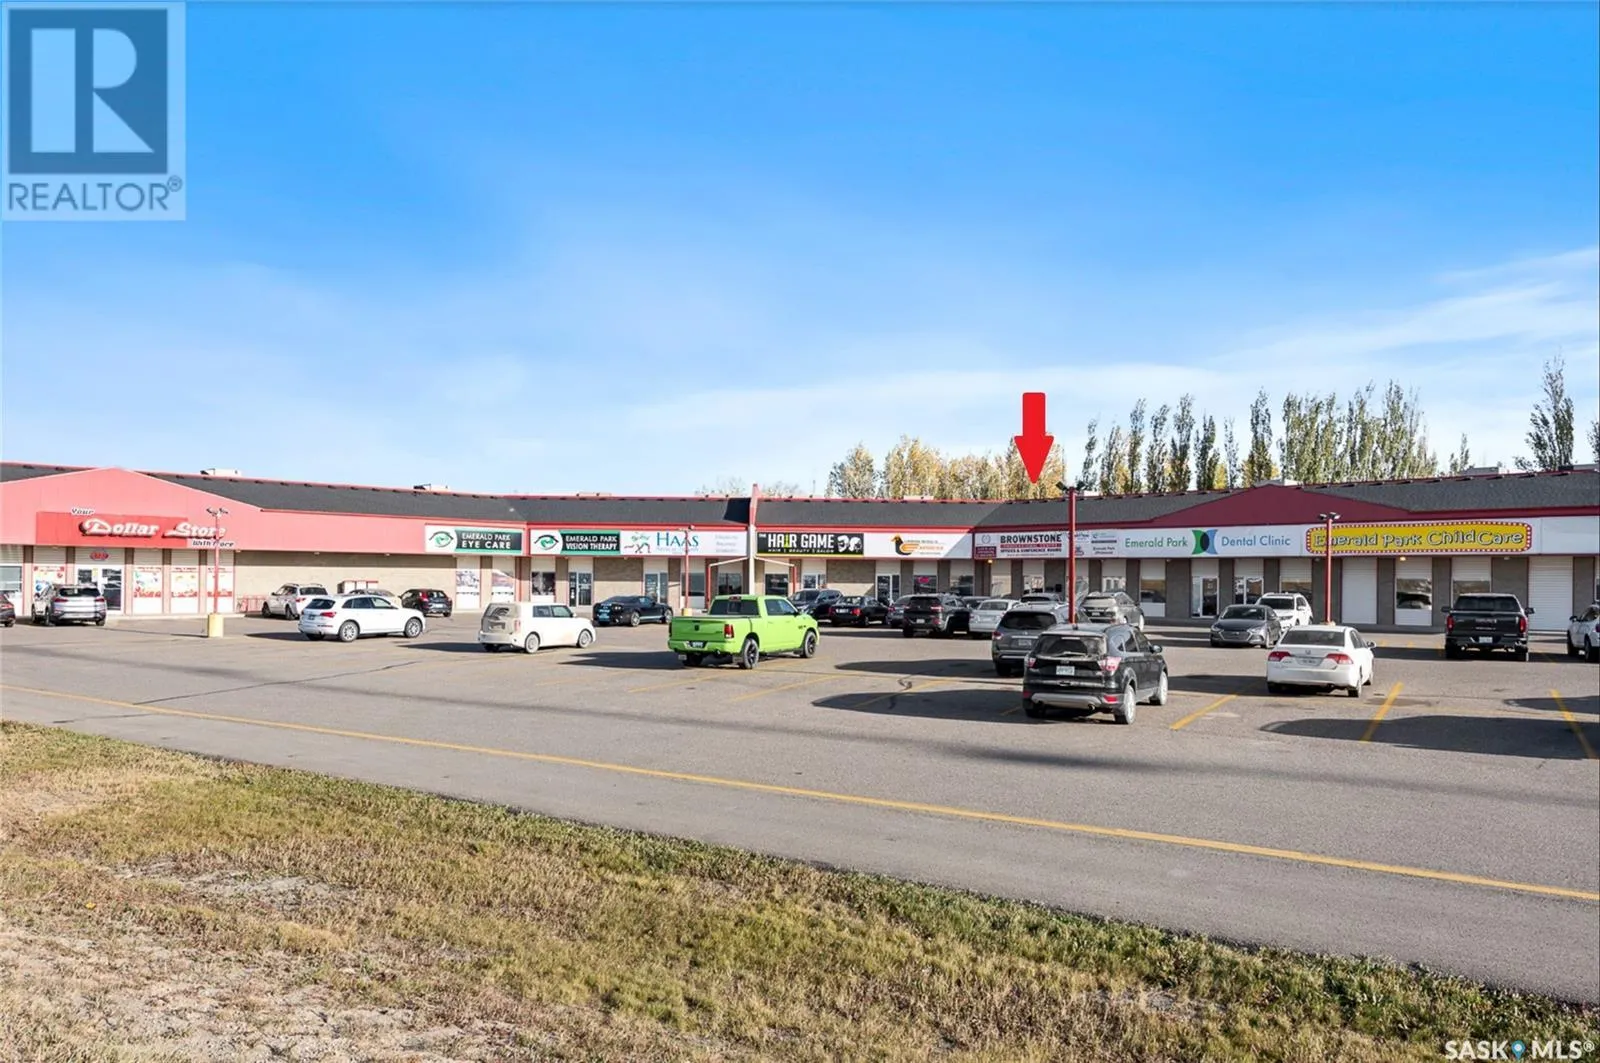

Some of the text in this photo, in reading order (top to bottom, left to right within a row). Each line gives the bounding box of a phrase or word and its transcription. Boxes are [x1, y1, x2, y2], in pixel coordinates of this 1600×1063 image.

[71, 507, 95, 515] Your
[79, 518, 227, 539] Dollar Store
[462, 532, 511, 542] EMERALD PARK
[566, 535, 597, 543] EMERALD
[768, 534, 835, 549] HAIR GAME
[1000, 534, 1062, 544] BROWNSTONE
[1221, 535, 1291, 546] Dental Clinic
[1383, 534, 1422, 546] Park
[462, 541, 511, 550] EYE CARE
[590, 543, 617, 551] THERAPY
[1125, 537, 1188, 548] Emerald Park
